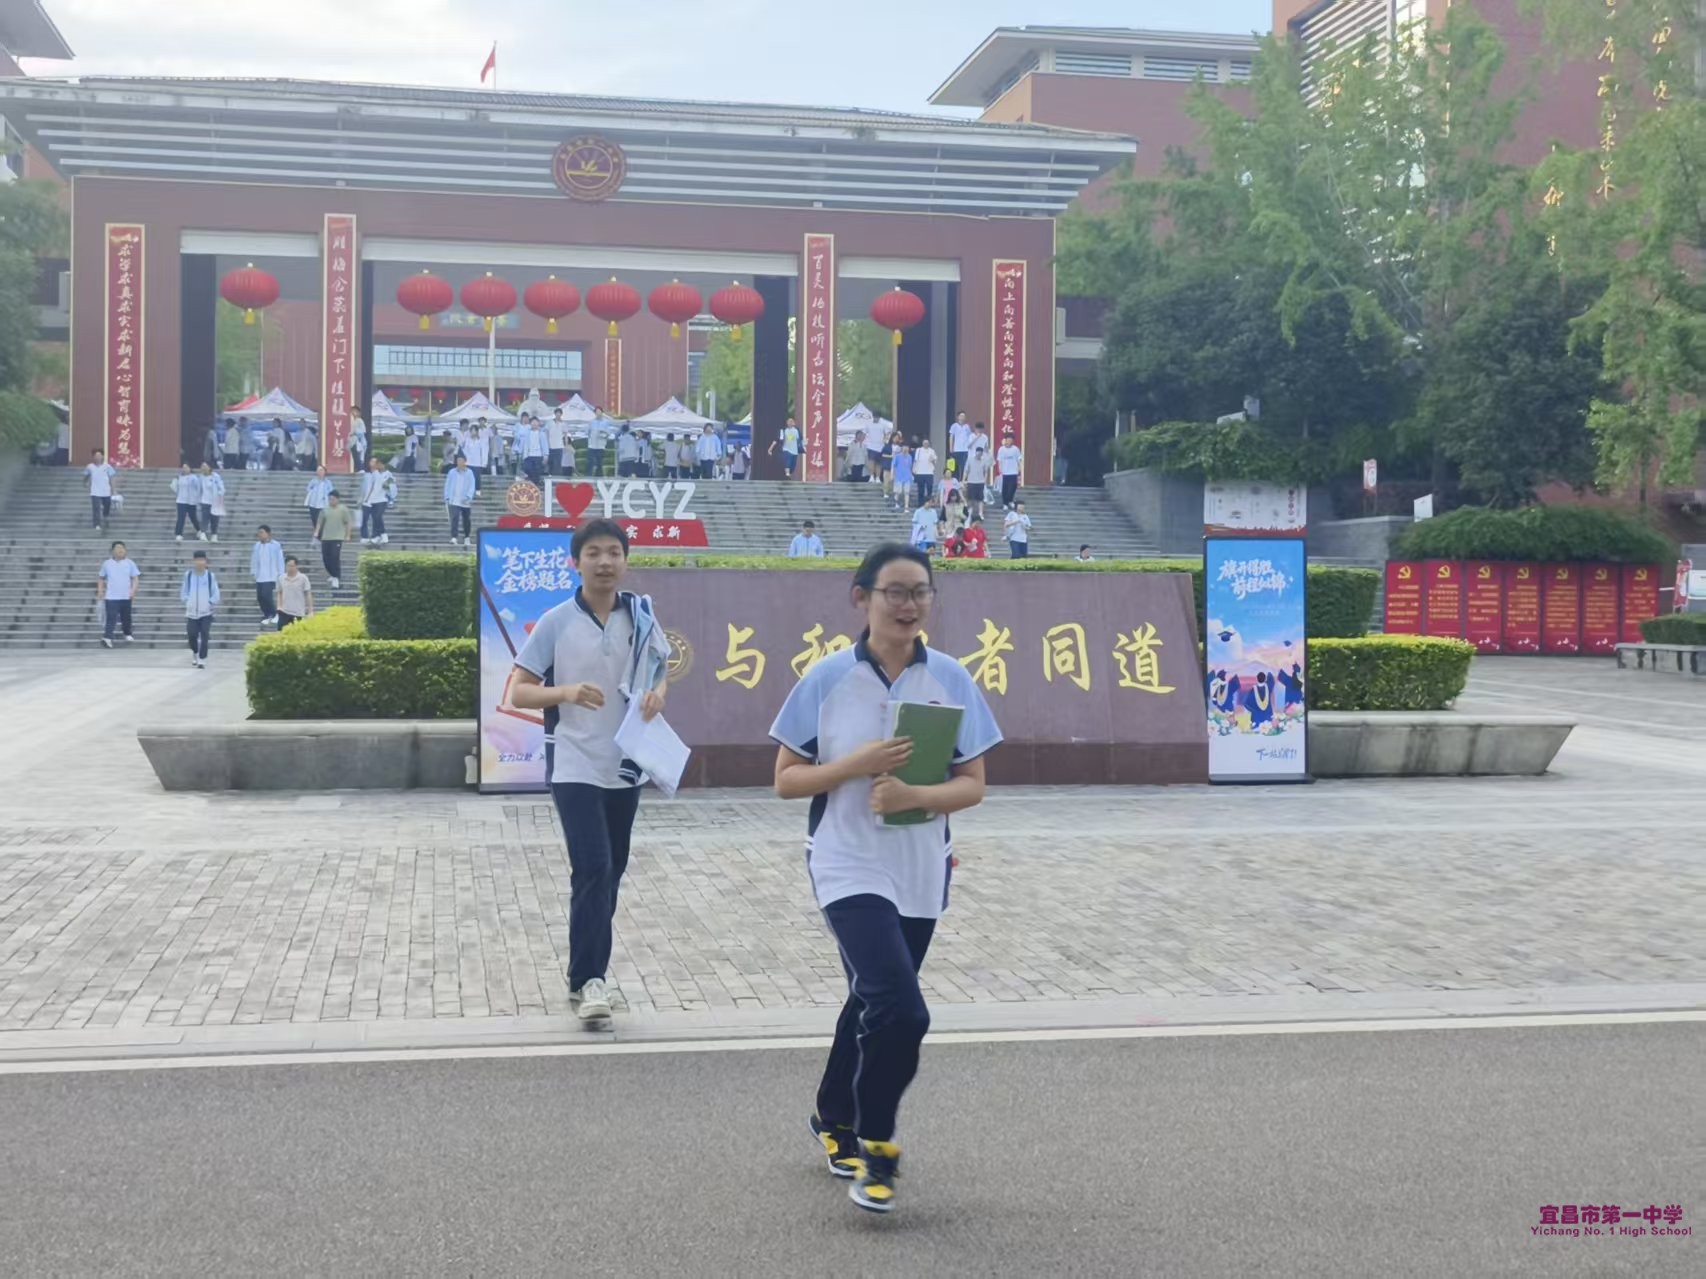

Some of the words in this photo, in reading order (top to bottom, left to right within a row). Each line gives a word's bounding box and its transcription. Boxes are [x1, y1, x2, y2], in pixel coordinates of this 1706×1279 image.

[544, 479, 553, 518] I
[596, 480, 697, 520] YCYZ
[652, 525, 681, 541] 求新
[501, 546, 569, 572] 笔下生花
[1217, 558, 1275, 582] 旗开得胜
[495, 568, 574, 594] 金榜题名
[1231, 571, 1288, 600] 前程似锦
[714, 618, 1177, 696] 与者同道
